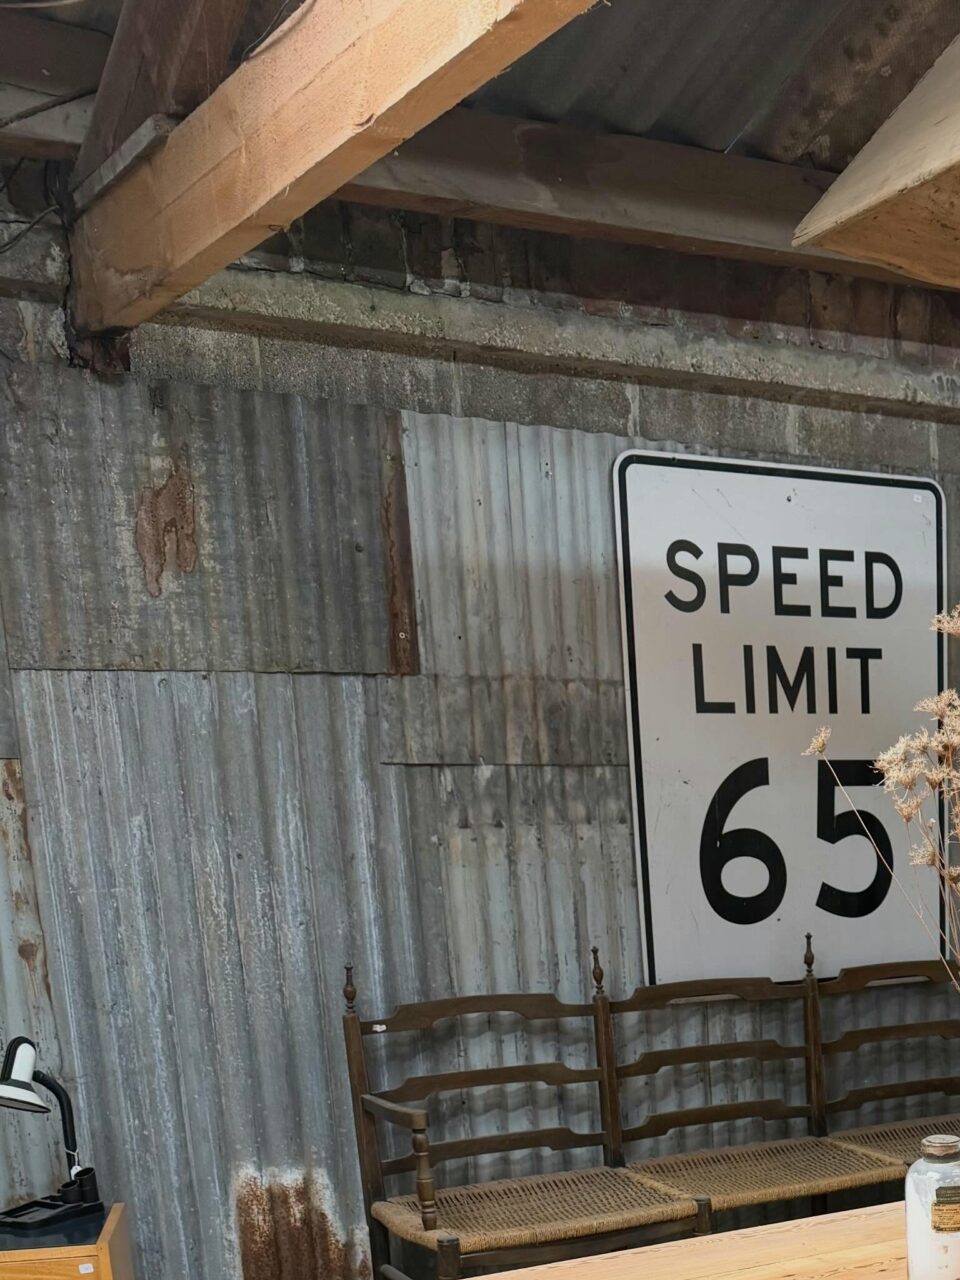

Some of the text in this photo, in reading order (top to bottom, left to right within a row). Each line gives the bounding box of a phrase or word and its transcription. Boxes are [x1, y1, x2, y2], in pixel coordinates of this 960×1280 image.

[664, 538, 903, 620] SPEED
[691, 642, 883, 715] LIMIT
[699, 757, 895, 925] 65
